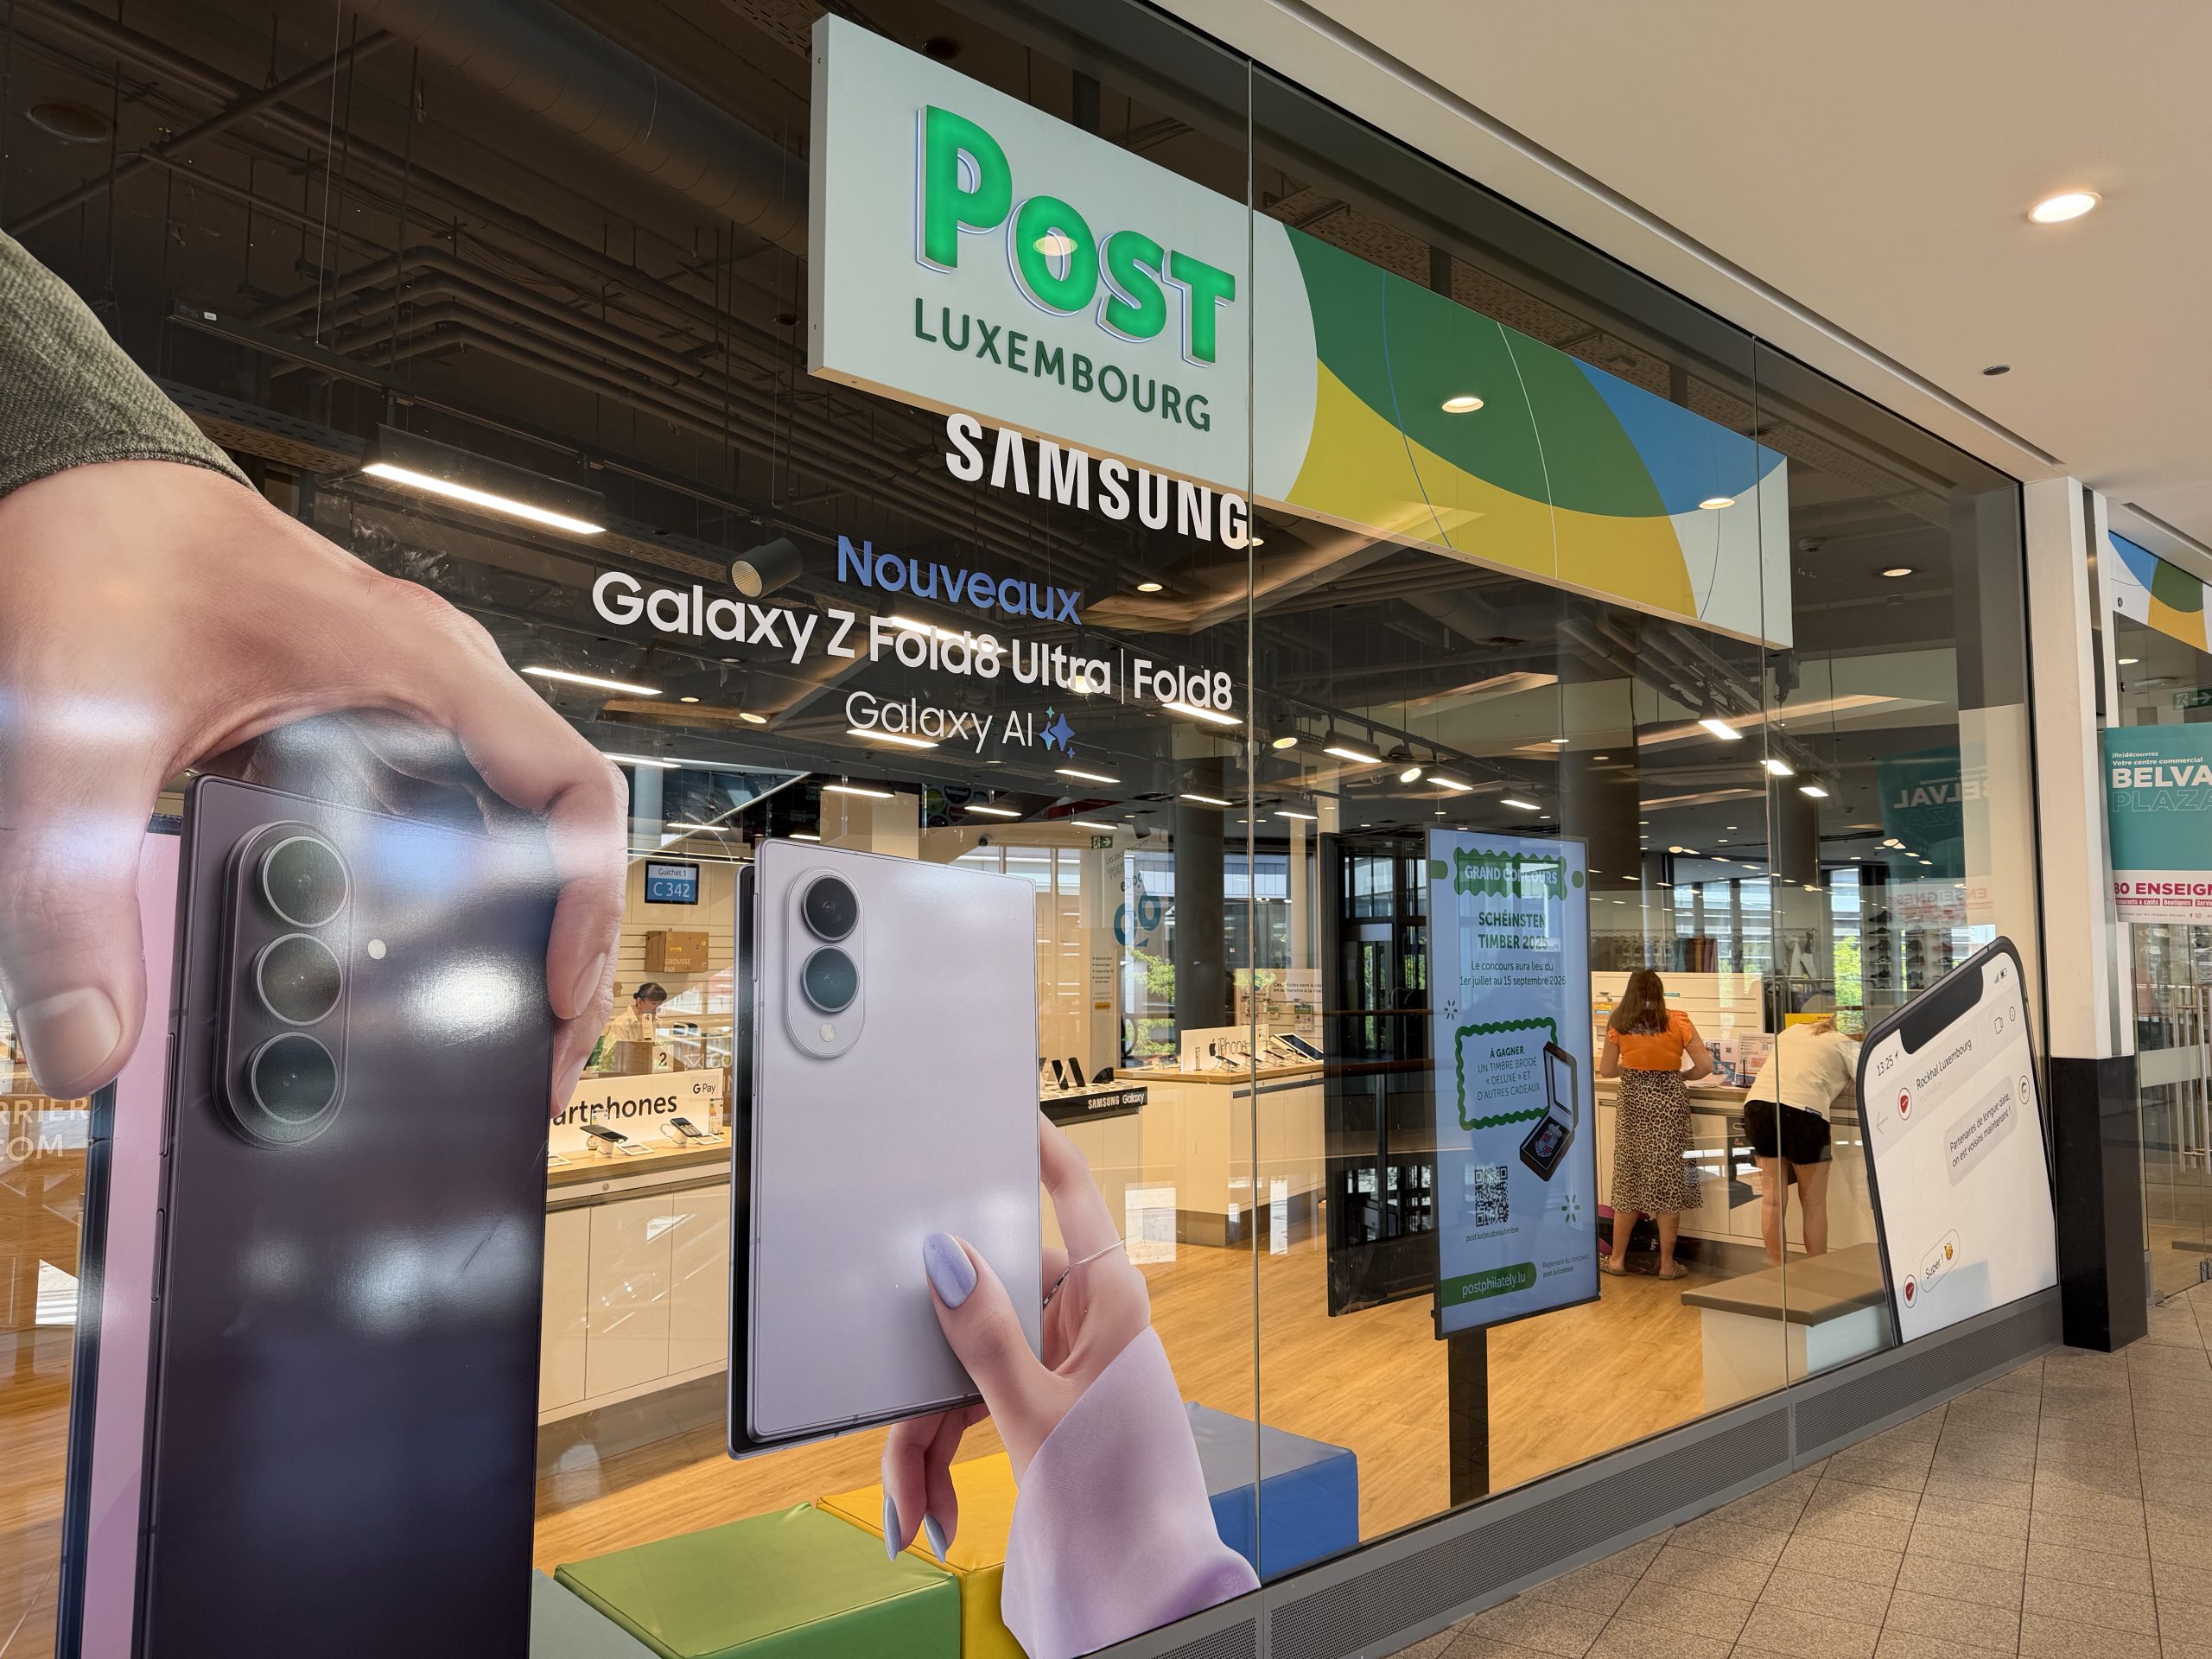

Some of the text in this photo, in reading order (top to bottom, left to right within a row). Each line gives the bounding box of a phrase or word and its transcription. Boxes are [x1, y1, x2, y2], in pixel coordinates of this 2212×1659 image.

[917, 105, 1236, 366] POST
[915, 297, 1211, 432] LUXEMBOURG
[945, 412, 1249, 550] SAMSUNG
[837, 534, 1082, 626] Nouveaux
[592, 571, 1232, 711] Galaxy Z Fold8 Ultra Fold8
[845, 691, 1032, 753] Galaxy AI
[658, 868, 682, 876] Guichet
[1465, 865, 1558, 885] GRAND CONCOURS
[653, 882, 690, 898] C 342
[1478, 910, 1546, 928] SCHÉINSTEN
[1478, 934, 1520, 949] TIMBER
[1471, 961, 1480, 971] Le
[1482, 963, 1514, 971] concours
[1531, 962, 1543, 971] lieu
[1545, 962, 1554, 971] du
[1459, 976, 1567, 988] 1er juillet au 15 septembre 2026
[1217, 1037, 1247, 1056] iPhone
[1496, 1046, 1524, 1058] GAGNER
[659, 1052, 668, 1067] 2
[1478, 1056, 1537, 1073] UN TIMBRE BRODÉ
[1877, 1055, 1893, 1077] 13:25
[1916, 1039, 1972, 1090] Rockhal Luxembourg
[1491, 1073, 1516, 1085] DELUXE
[1523, 1071, 1530, 1080] ET
[702, 1083, 716, 1094] Pay
[1478, 1083, 1541, 1101] D'AUTRES CADEAUX
[1088, 1093, 1145, 1110] SAMSUNG Galaxy
[1949, 1123, 1976, 1153] Partenaires
[1976, 1117, 1983, 1128] de
[1983, 1103, 1999, 1122] longue
[1953, 1156, 1960, 1167] on
[1967, 1134, 1984, 1154] voisins
[1983, 1109, 2009, 1139] maintenant
[0, 1134, 63, 1162] OM
[1925, 1259, 1941, 1279] Super
[1462, 1271, 1526, 1299] postphilately.lu
